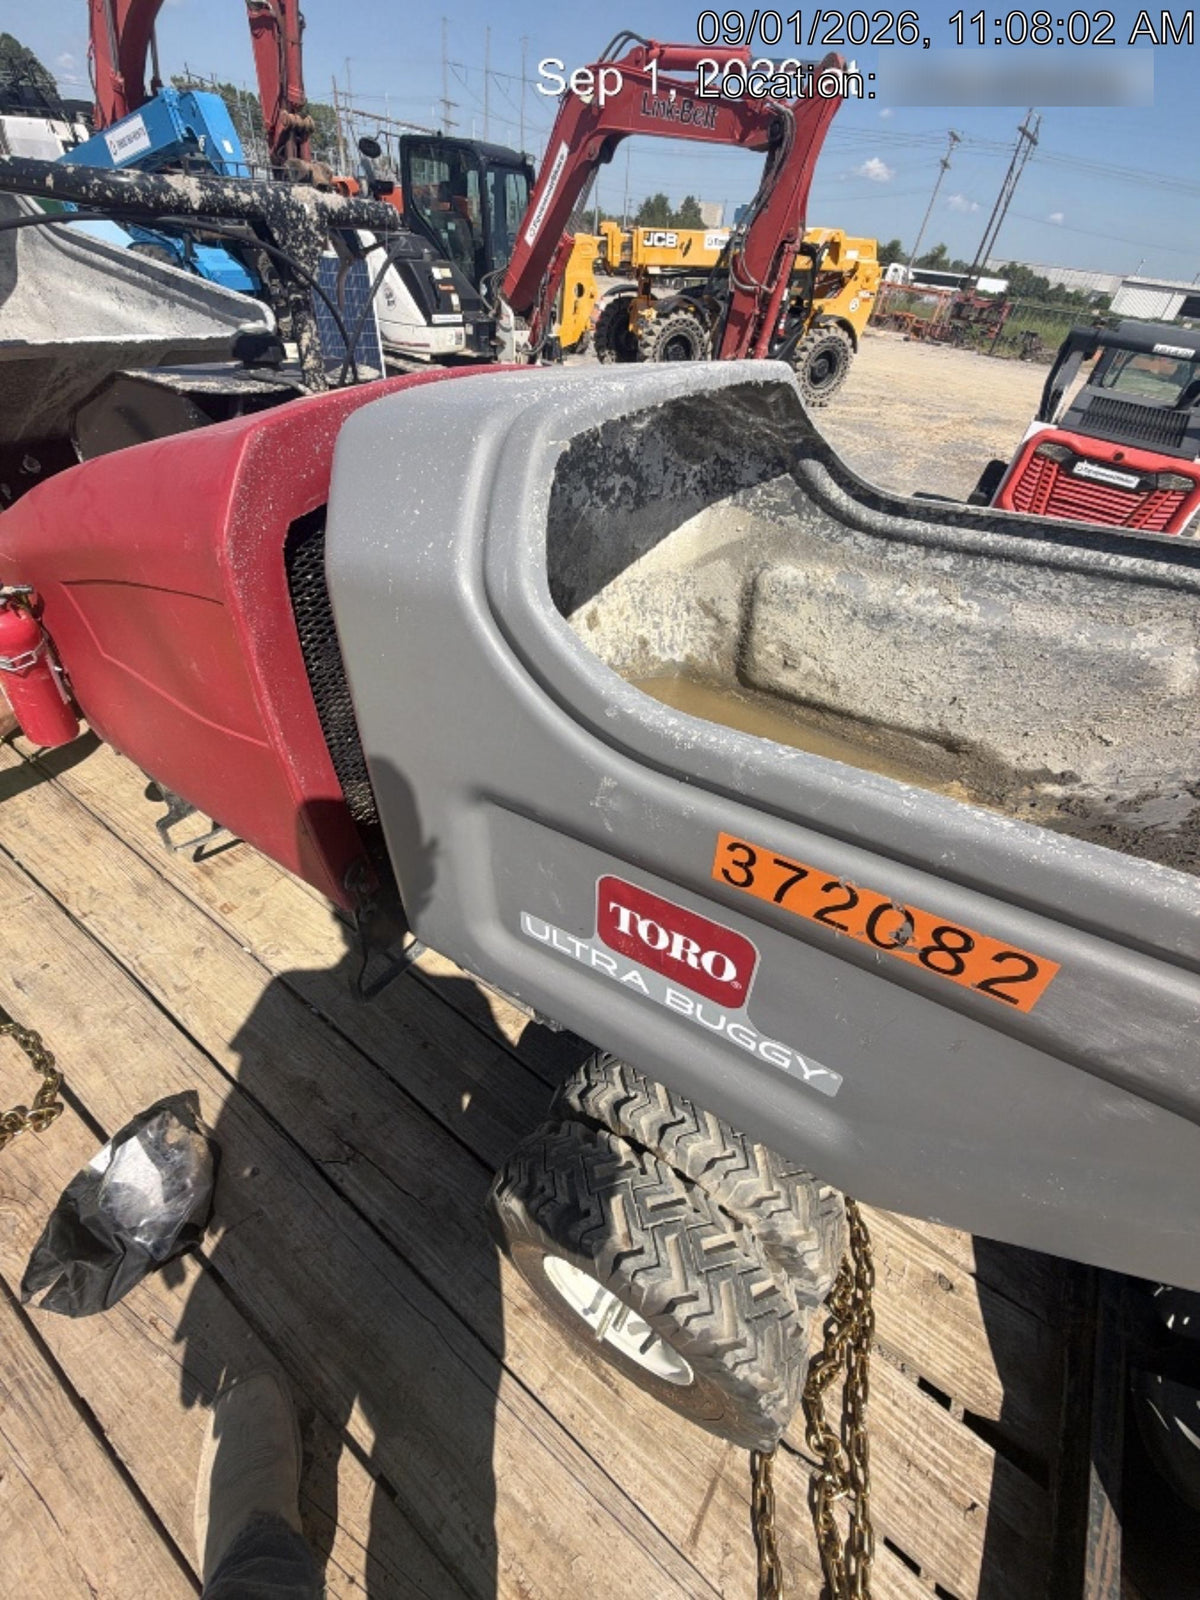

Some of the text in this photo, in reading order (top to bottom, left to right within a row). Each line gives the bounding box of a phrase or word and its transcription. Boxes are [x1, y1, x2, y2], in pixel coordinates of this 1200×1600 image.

[641, 91, 719, 131] Link-Belt
[642, 231, 678, 248] JCB
[721, 841, 1040, 1006] 372082
[524, 915, 832, 1081] ULTRA BUGGY
